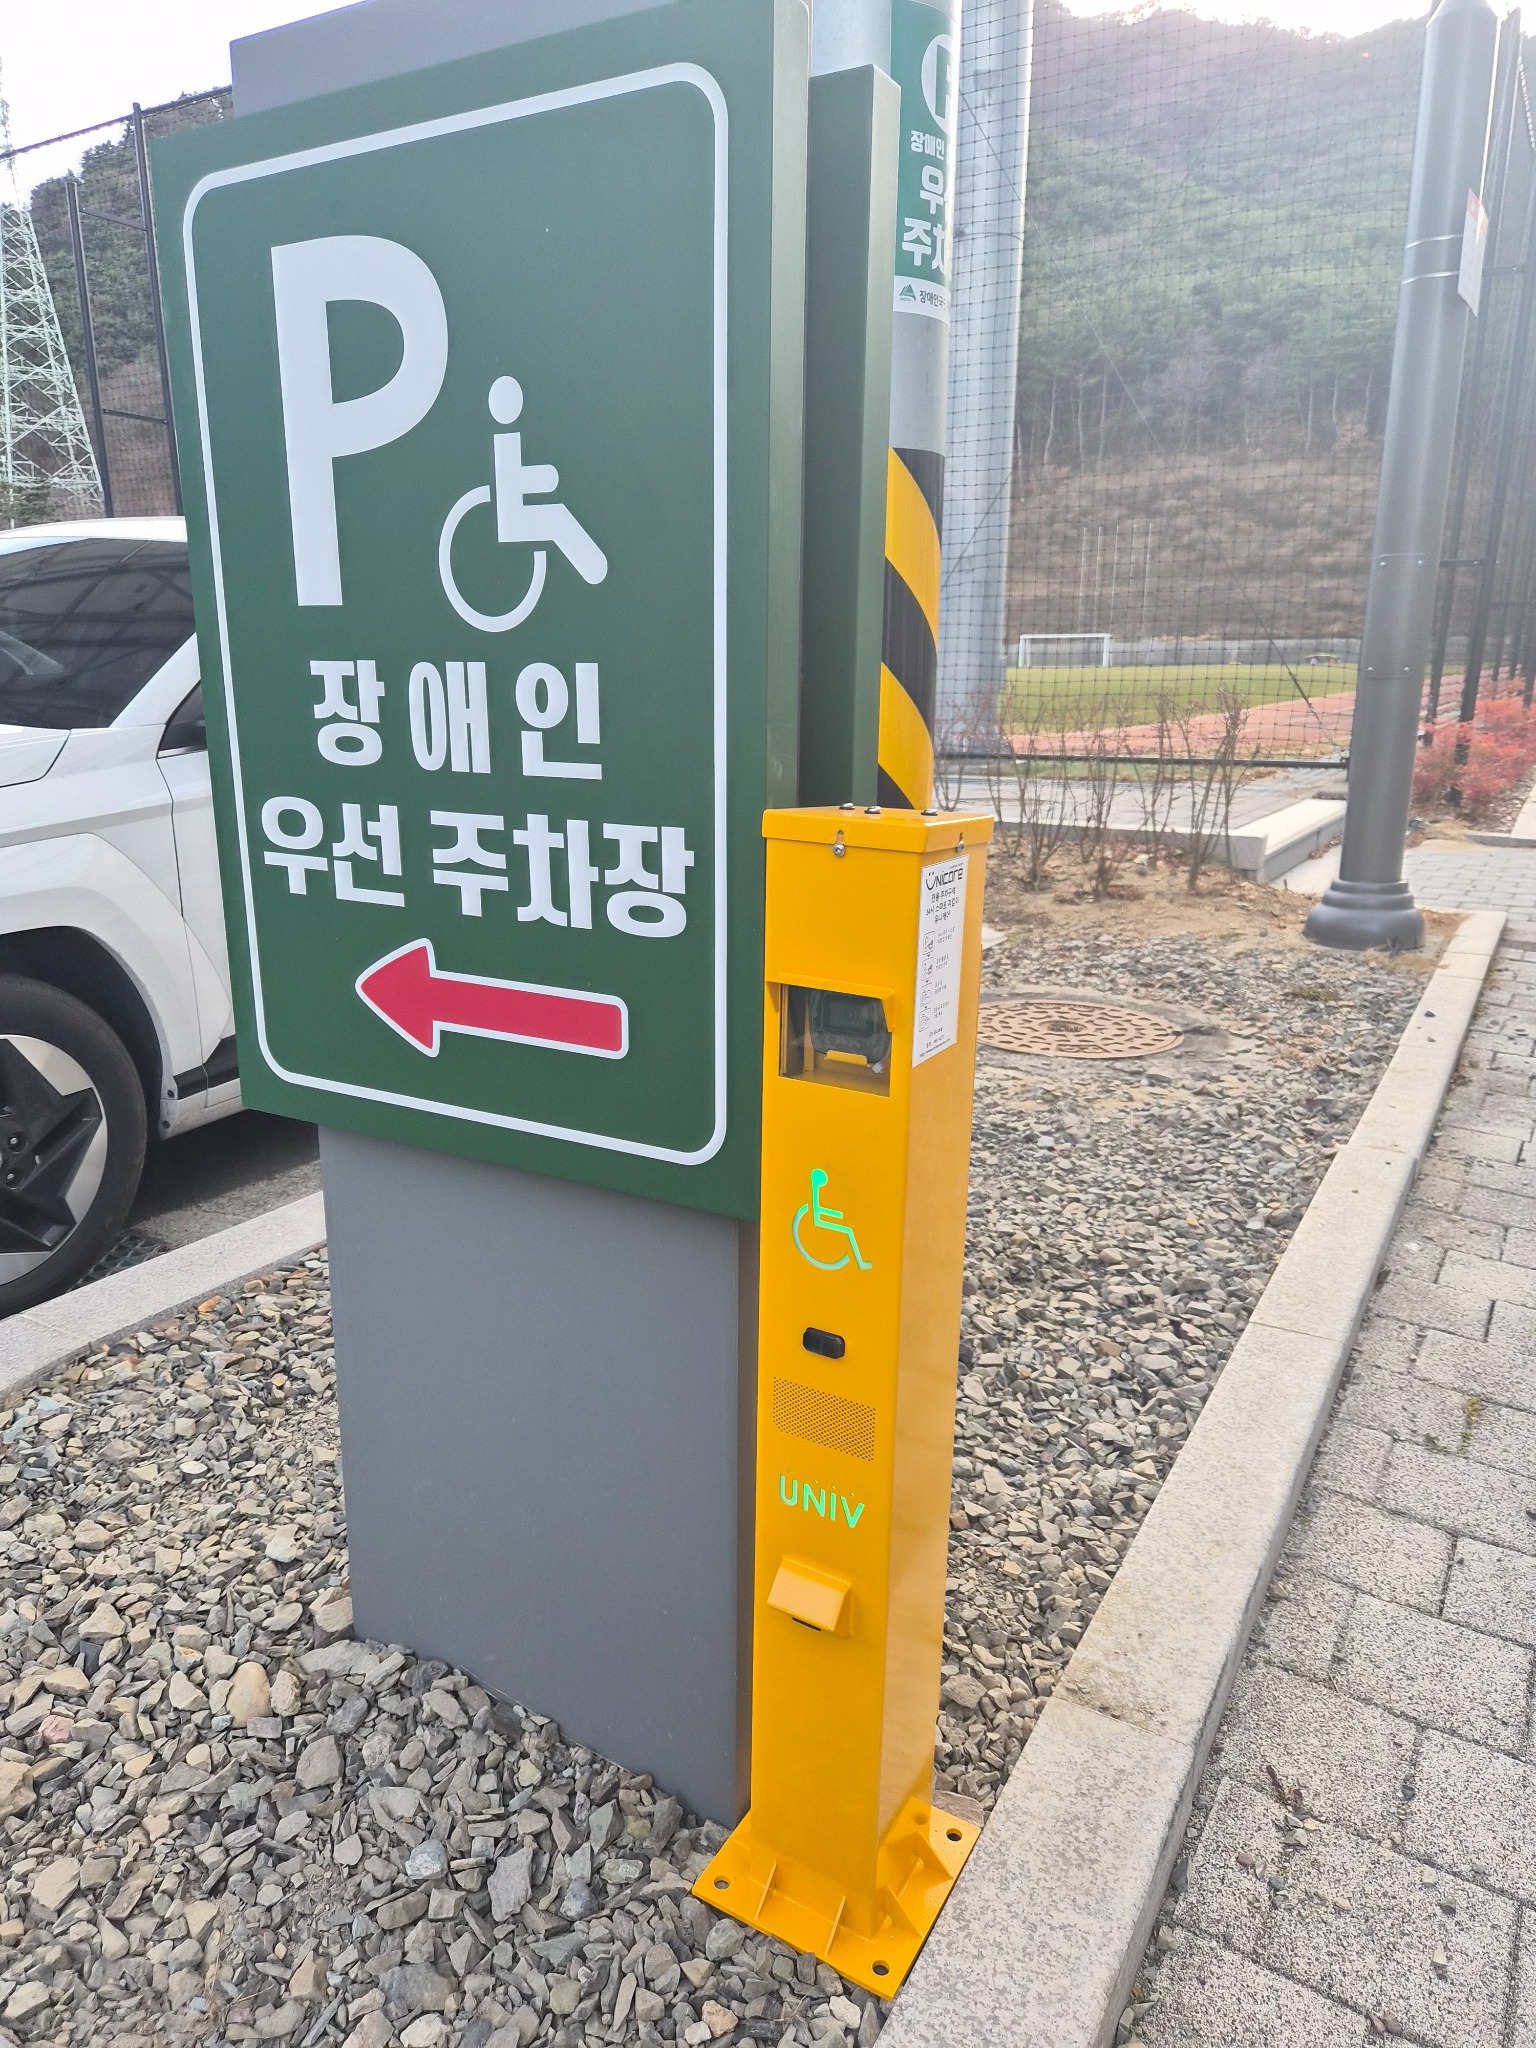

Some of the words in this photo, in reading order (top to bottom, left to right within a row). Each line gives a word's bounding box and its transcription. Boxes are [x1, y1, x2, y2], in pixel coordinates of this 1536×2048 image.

[910, 130, 945, 161] 장애인
[919, 165, 948, 215] 우
[270, 234, 449, 607] P
[309, 659, 603, 781] 장애인
[260, 796, 406, 908] 우선
[429, 809, 695, 938] 주차장
[779, 1473, 866, 1529] UNIV
